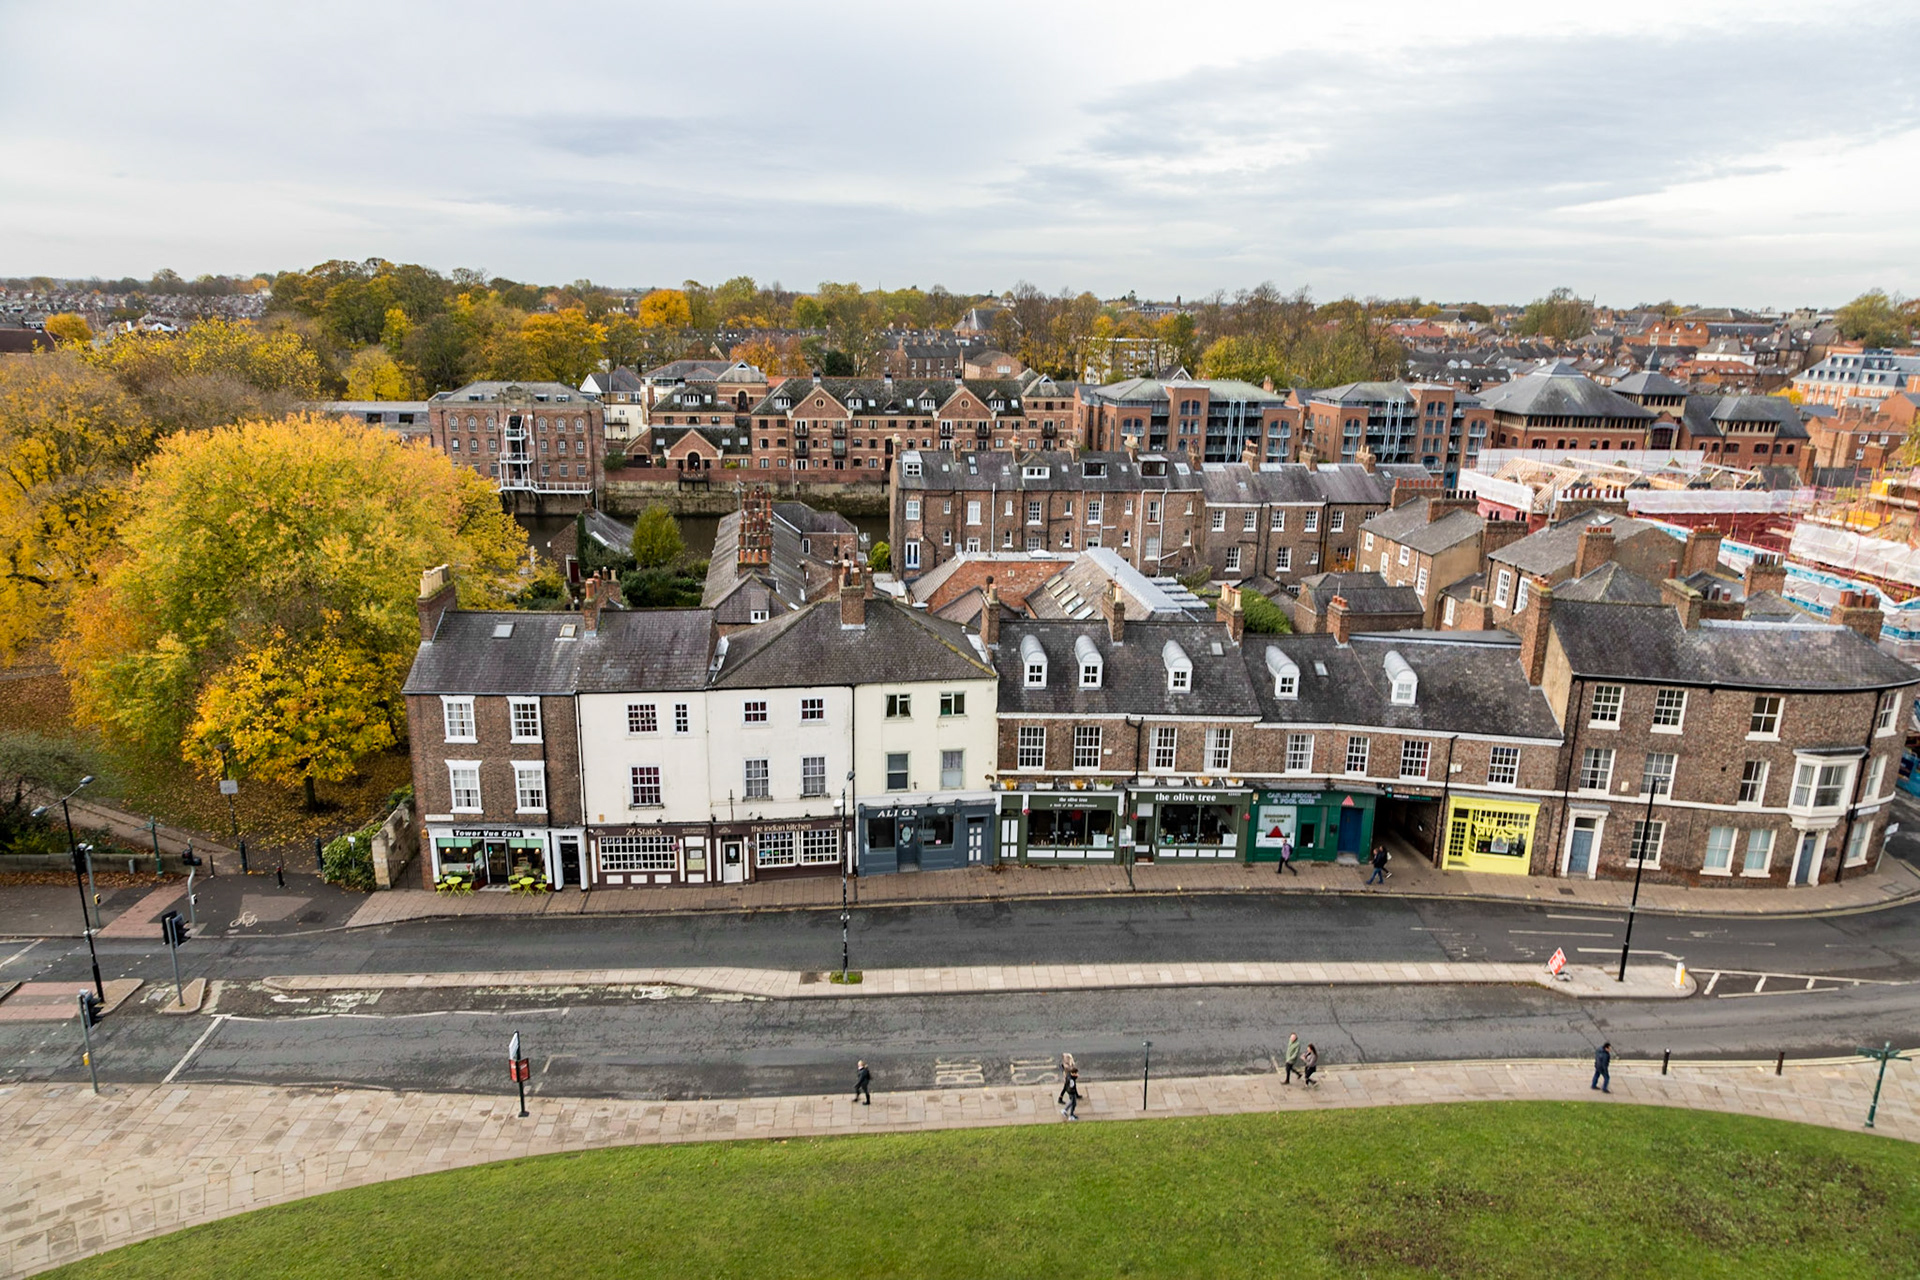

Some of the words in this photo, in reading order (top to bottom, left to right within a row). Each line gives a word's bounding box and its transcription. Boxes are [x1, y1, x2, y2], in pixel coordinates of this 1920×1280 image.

[1155, 792, 1170, 801] the
[1173, 792, 1194, 801] olive
[1198, 793, 1216, 802] tree
[877, 809, 899, 818] ALI
[626, 828, 636, 836] 29
[751, 825, 763, 833] the
[764, 824, 785, 832] indian
[786, 823, 811, 831] kitchen
